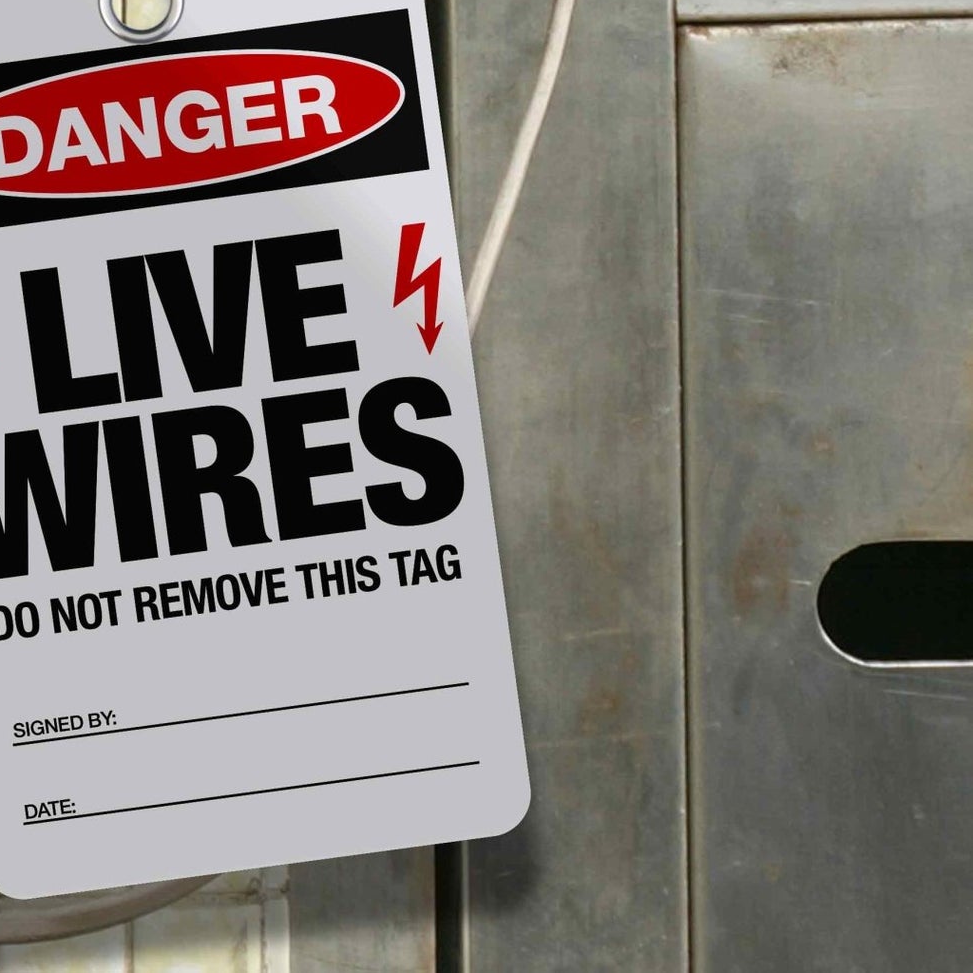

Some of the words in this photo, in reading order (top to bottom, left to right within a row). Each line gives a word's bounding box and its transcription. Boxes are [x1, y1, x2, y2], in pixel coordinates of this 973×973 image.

[19, 228, 360, 415] LIVE
[49, 589, 123, 634] NOT
[132, 567, 290, 623] REMOVE
[294, 555, 381, 600] THIS
[388, 544, 462, 587] TAG
[12, 714, 84, 738] SIGNED
[87, 709, 118, 729] BY:
[23, 798, 77, 820] DATE:
